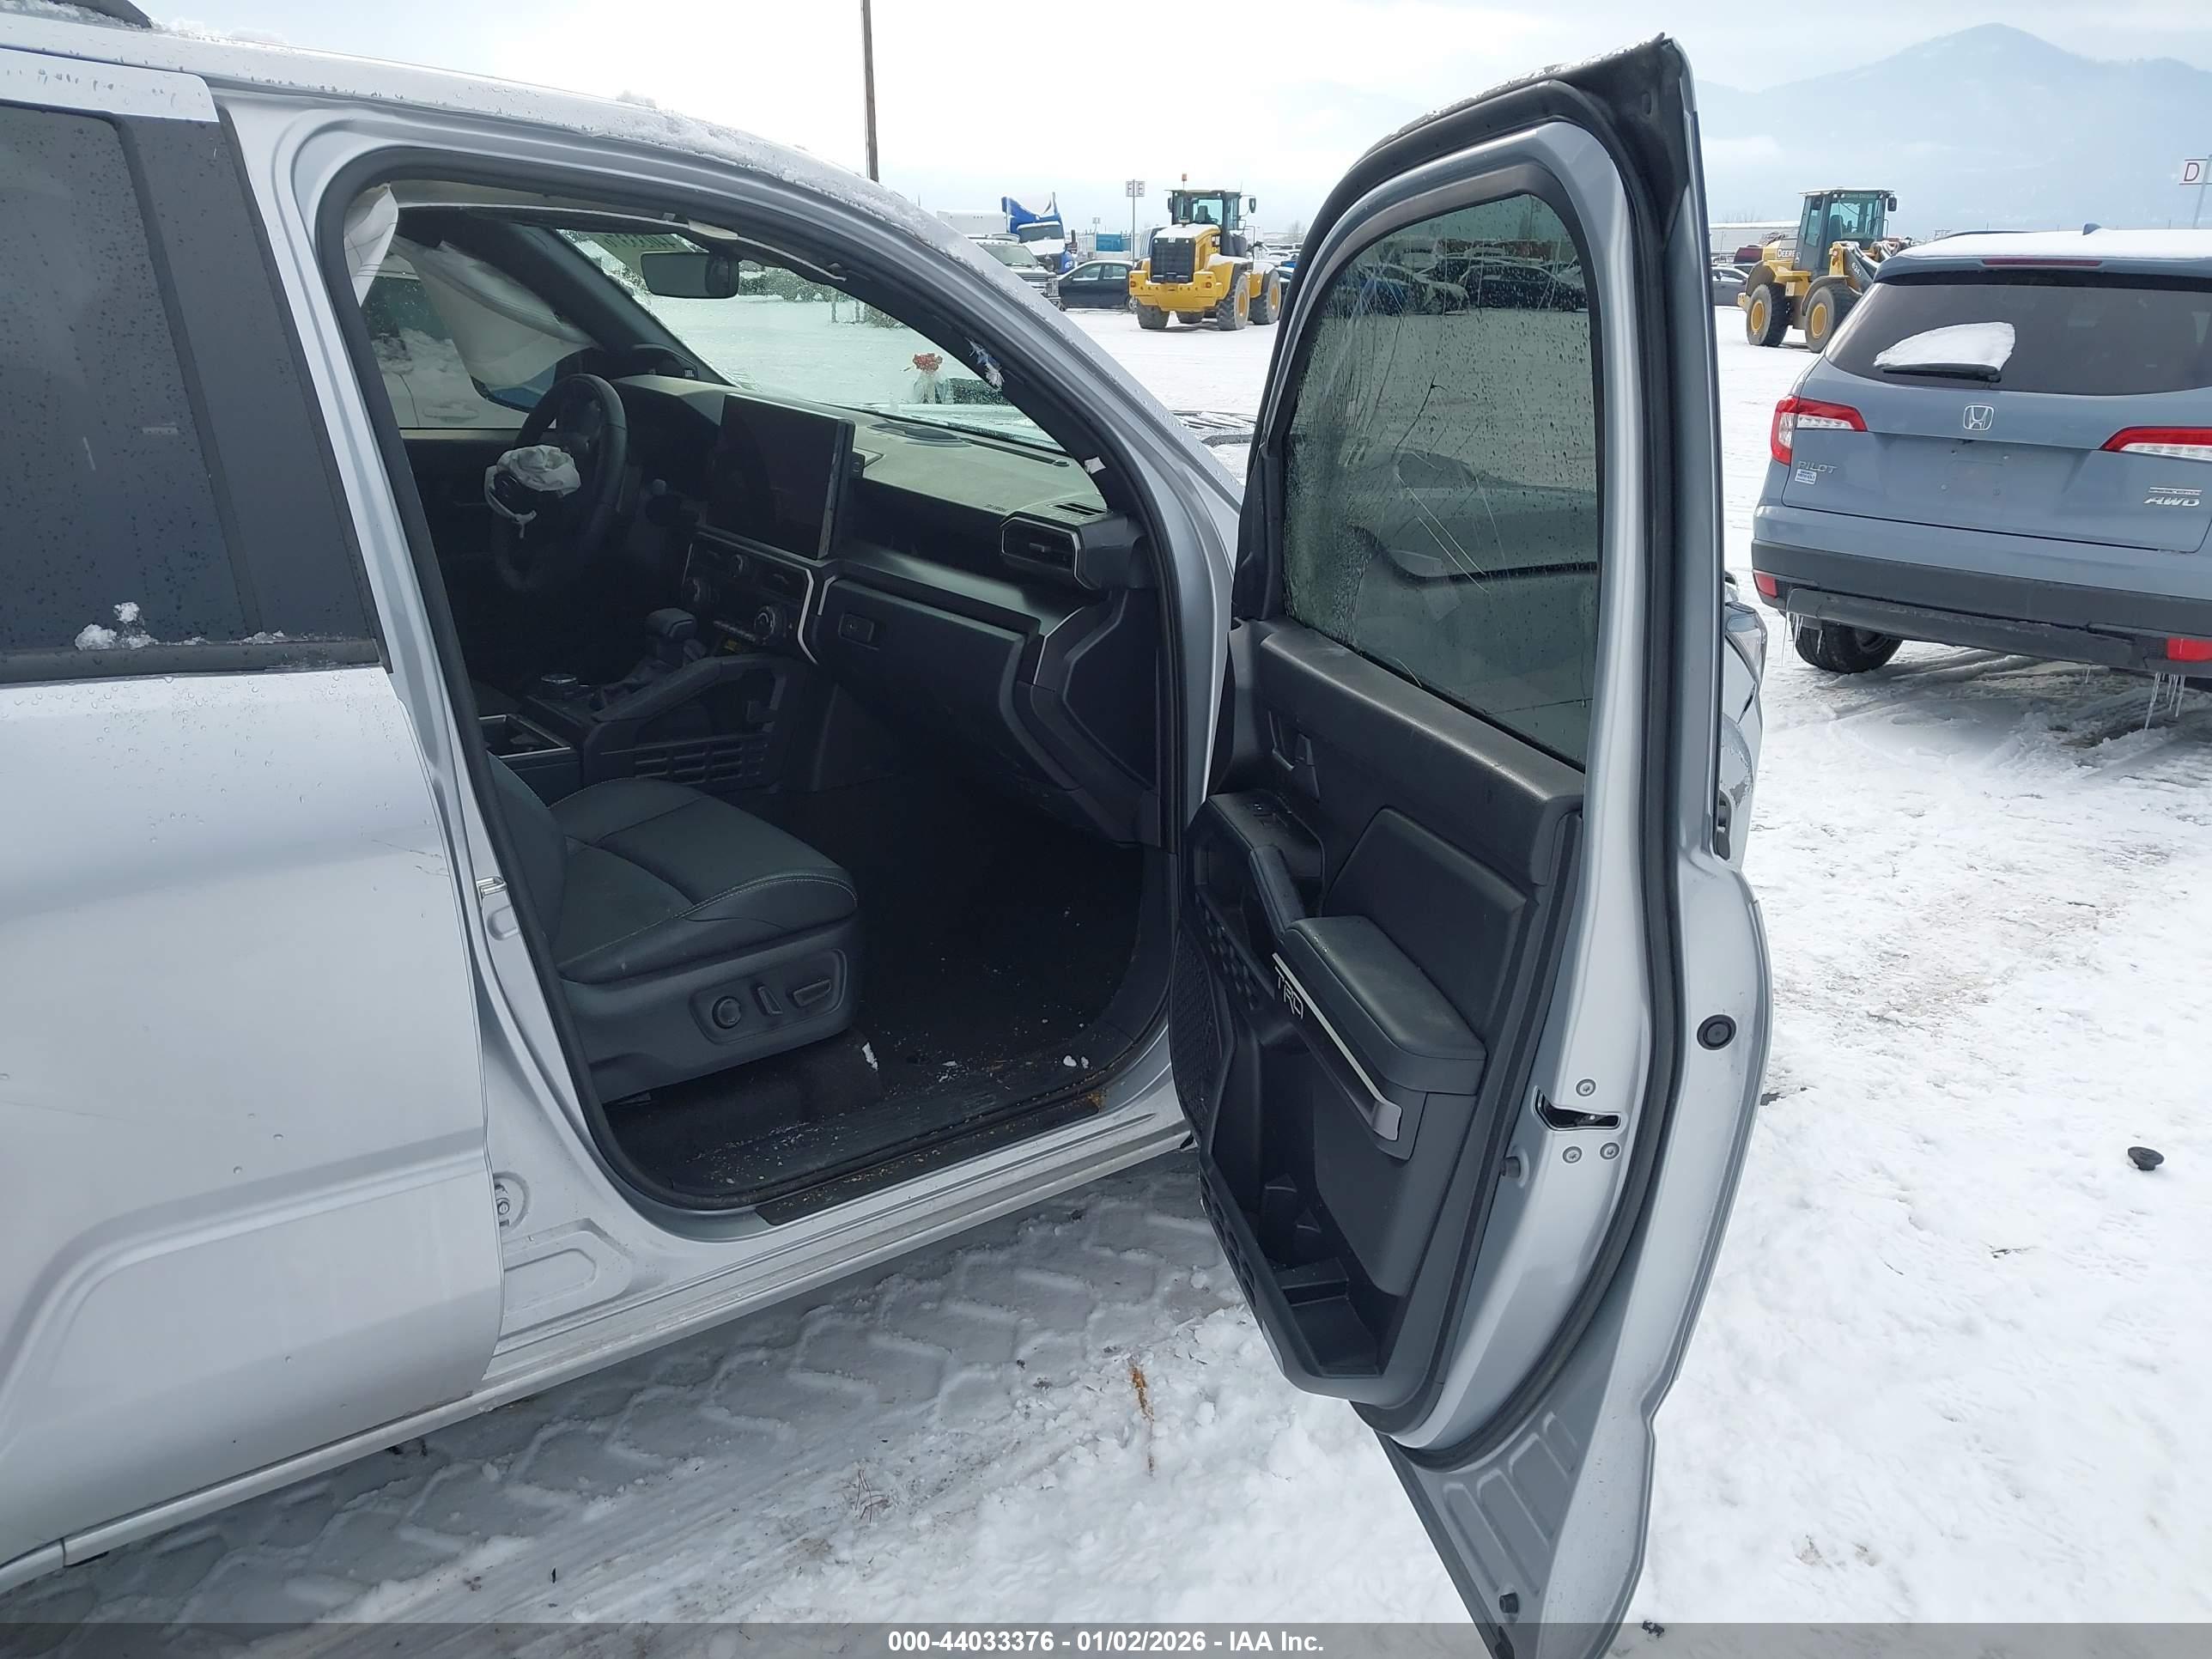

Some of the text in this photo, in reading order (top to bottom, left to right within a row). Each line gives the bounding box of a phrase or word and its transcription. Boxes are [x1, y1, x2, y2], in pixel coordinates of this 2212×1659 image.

[2184, 162, 2200, 182] D
[1778, 249, 1796, 258] DEERE
[1799, 460, 1838, 473] PILOT
[2143, 497, 2200, 507] AWD
[1274, 965, 1304, 1020] TRD
